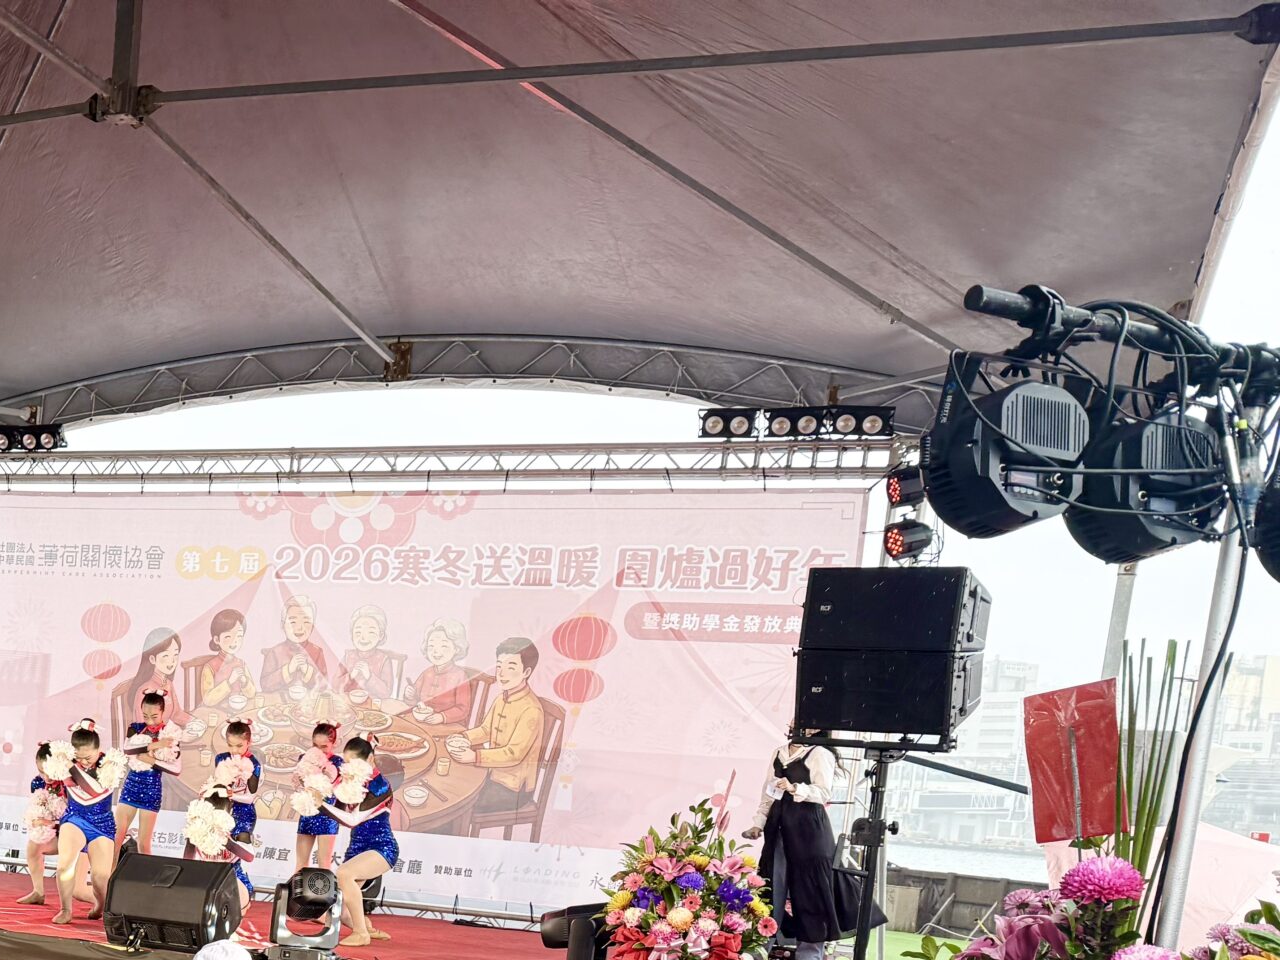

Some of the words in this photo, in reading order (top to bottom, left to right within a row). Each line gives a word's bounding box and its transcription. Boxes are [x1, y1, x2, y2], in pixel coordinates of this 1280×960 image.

[38, 544, 165, 570] 薄荷關懷協會
[182, 551, 260, 574] 第七屆
[274, 545, 599, 588] 2026寒冬送溫暖
[433, 865, 473, 878] 贊助單位
